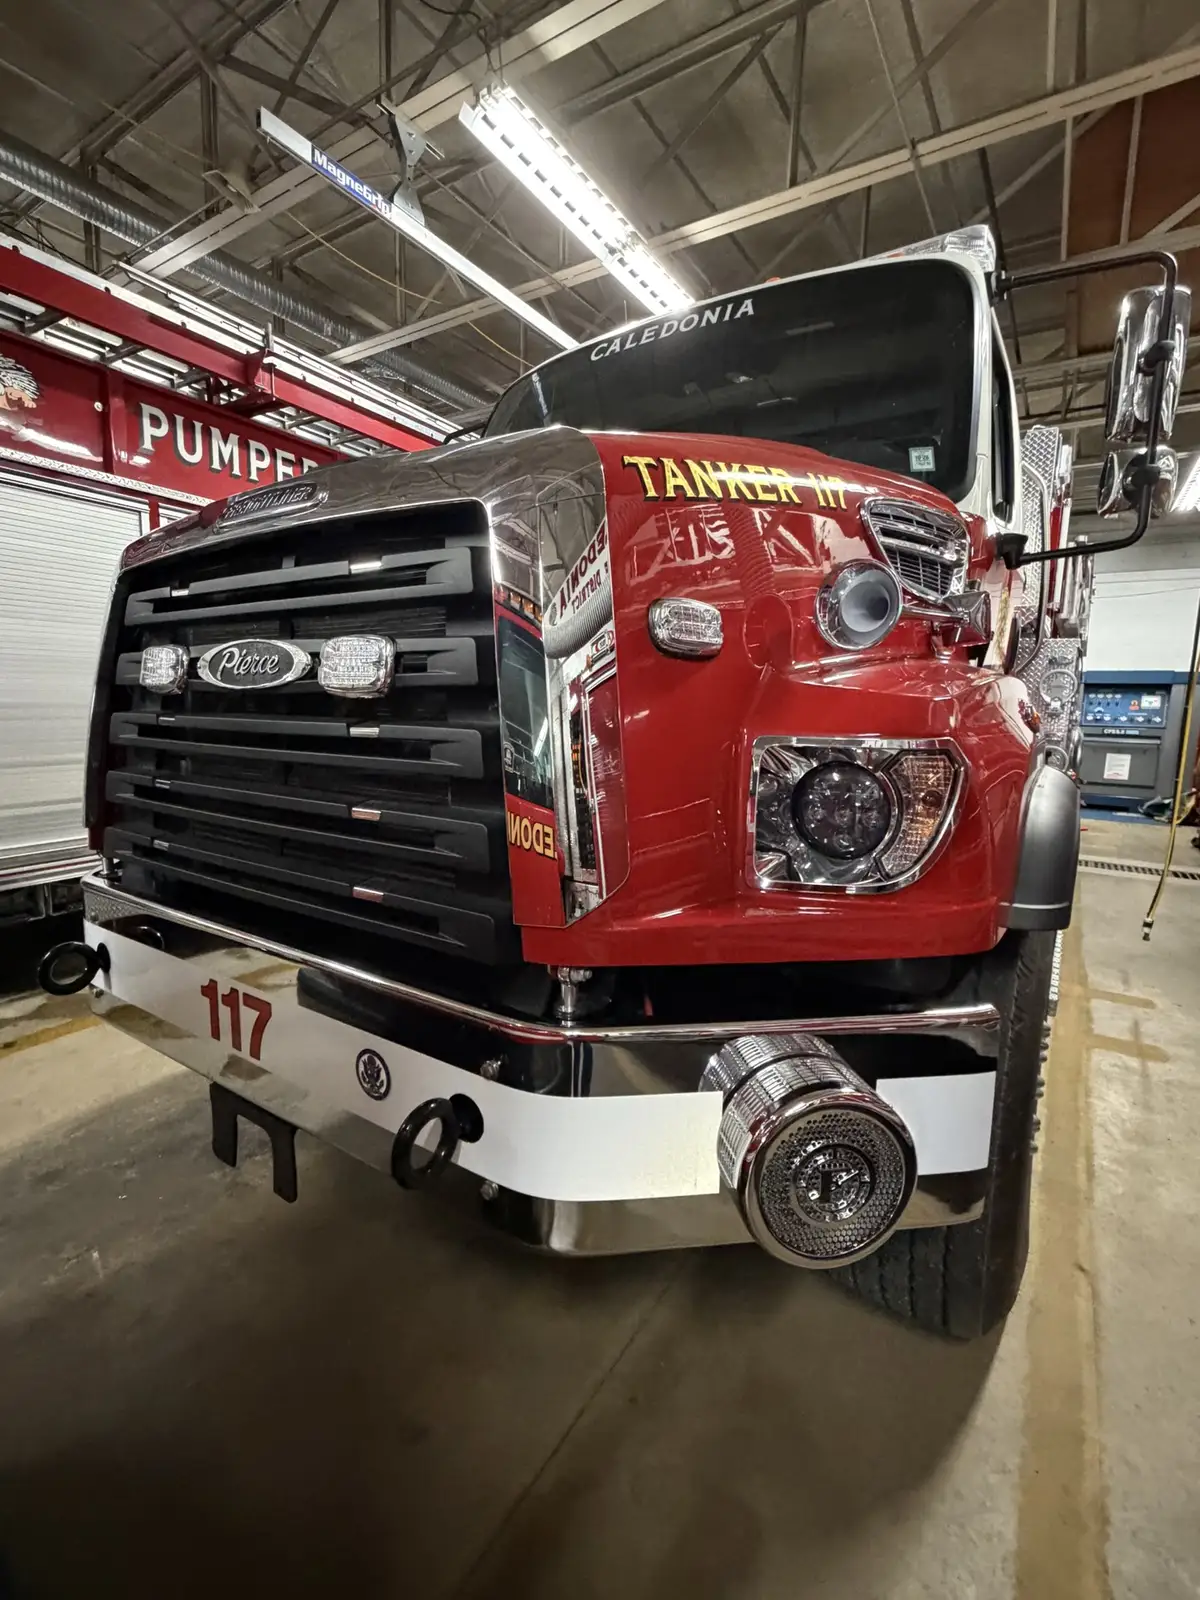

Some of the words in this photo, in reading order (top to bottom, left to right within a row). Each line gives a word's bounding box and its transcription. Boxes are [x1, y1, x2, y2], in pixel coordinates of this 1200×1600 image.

[314, 148, 391, 218] MagneGrip
[590, 299, 755, 361] CALEDONIA
[622, 455, 803, 505] TANKER
[806, 472, 848, 510] 117
[217, 647, 280, 681] Pierce
[200, 978, 272, 1061] 117
